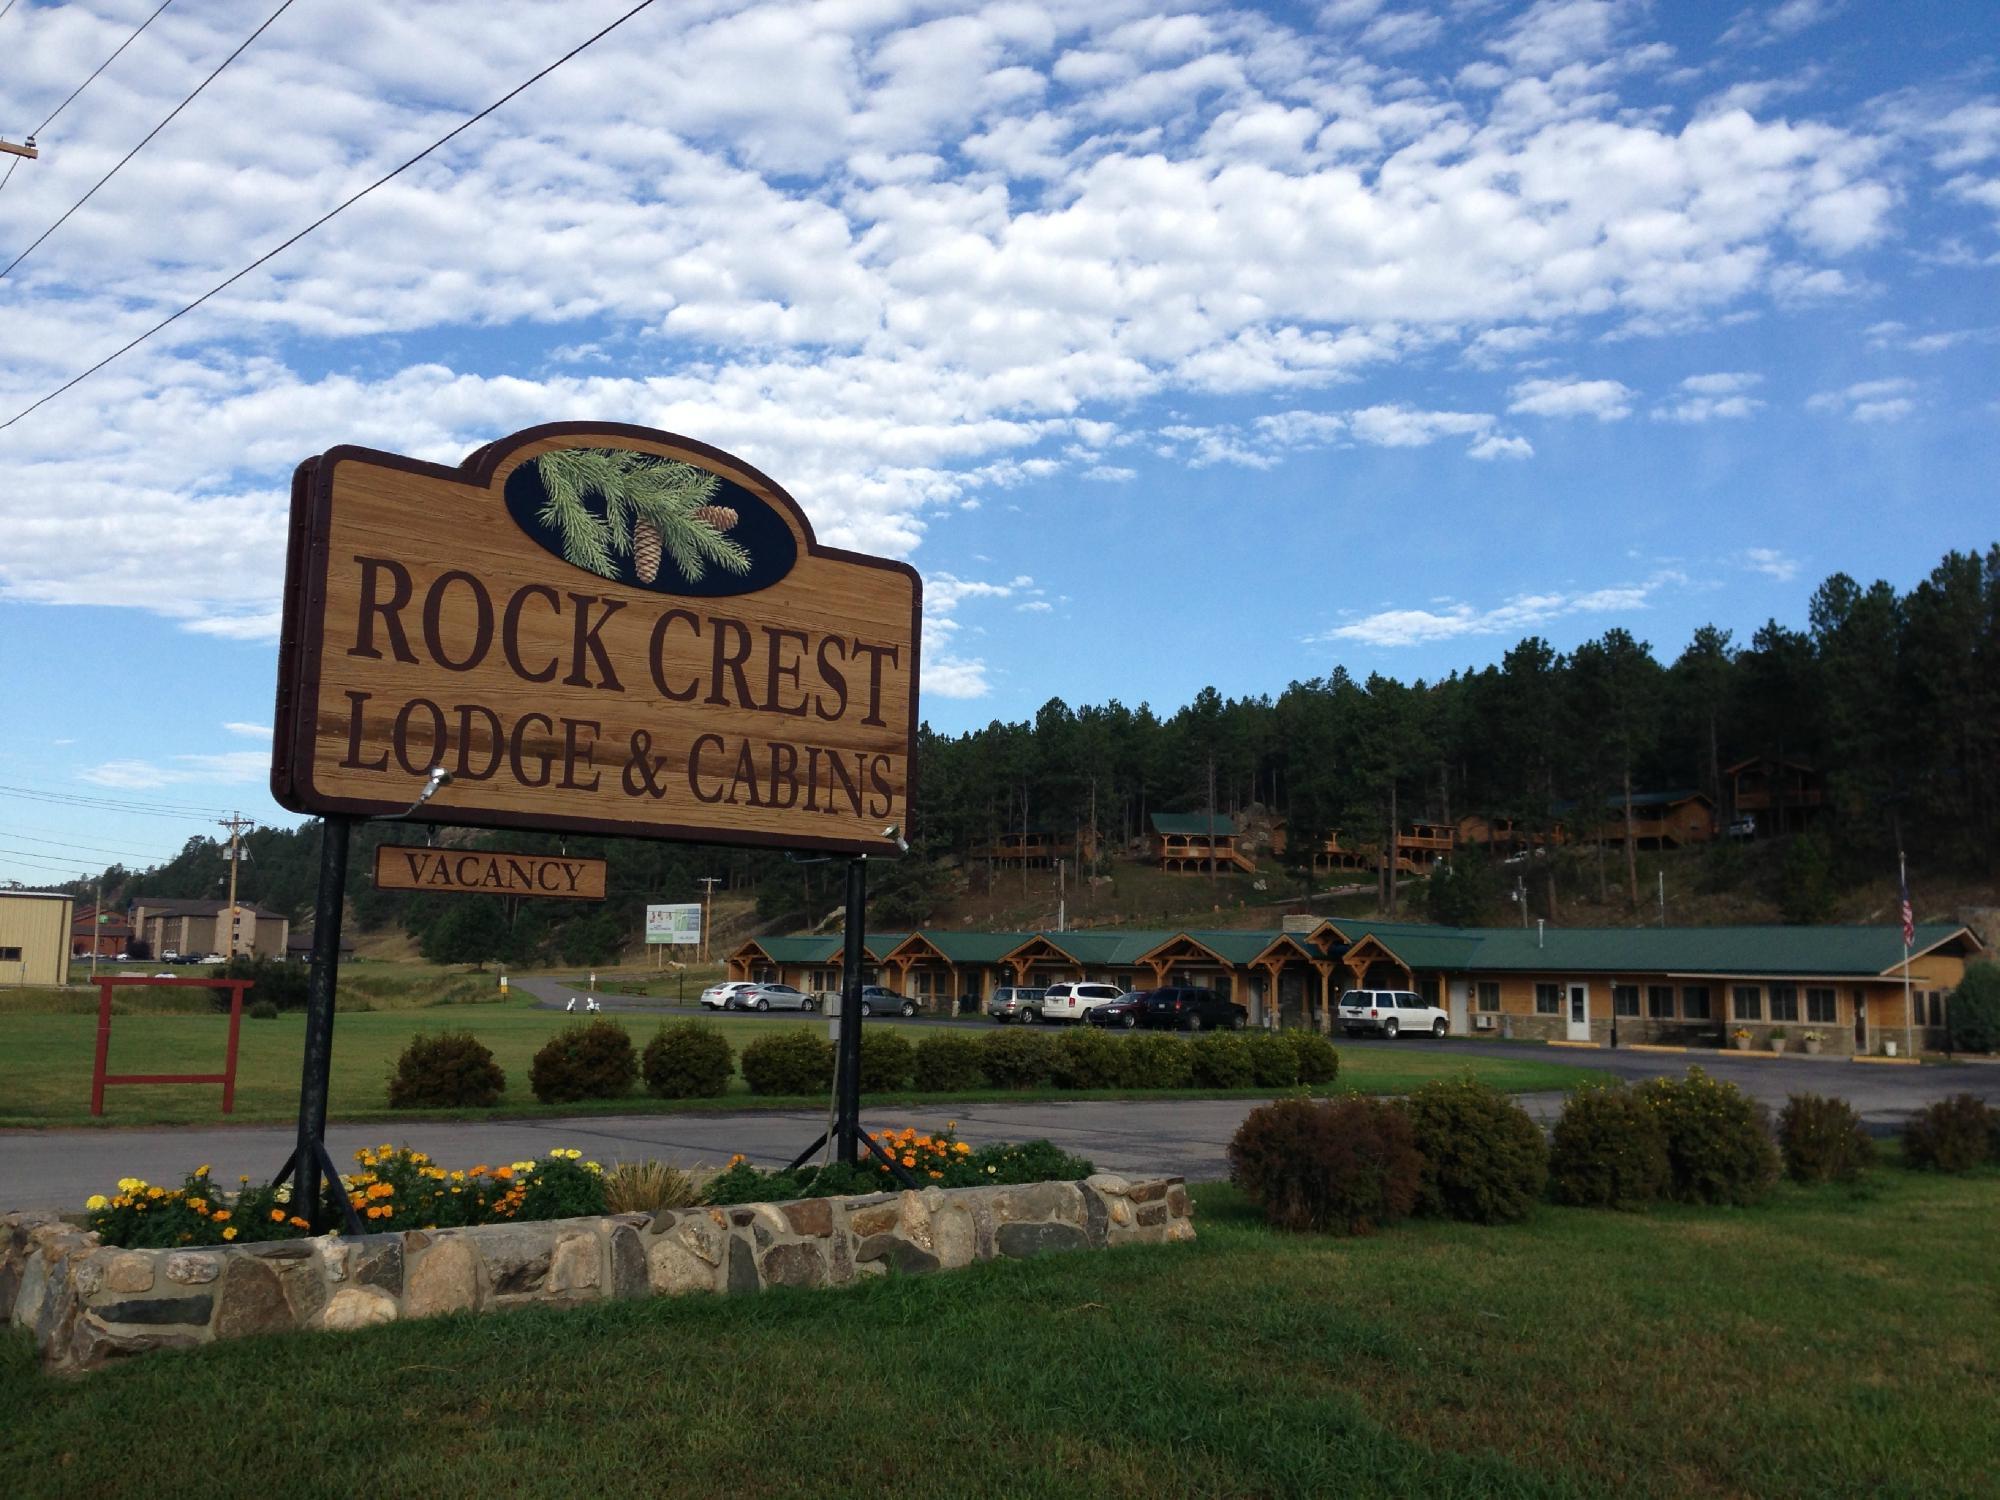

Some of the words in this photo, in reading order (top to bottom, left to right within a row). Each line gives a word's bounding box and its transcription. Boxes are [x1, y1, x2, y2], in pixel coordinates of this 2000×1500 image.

[347, 555, 627, 693] ROCK
[649, 608, 899, 728] CREST
[339, 691, 601, 792] LODGE
[622, 729, 667, 799] &
[688, 734, 893, 819] CABINS
[404, 853, 587, 894] VACANCY
